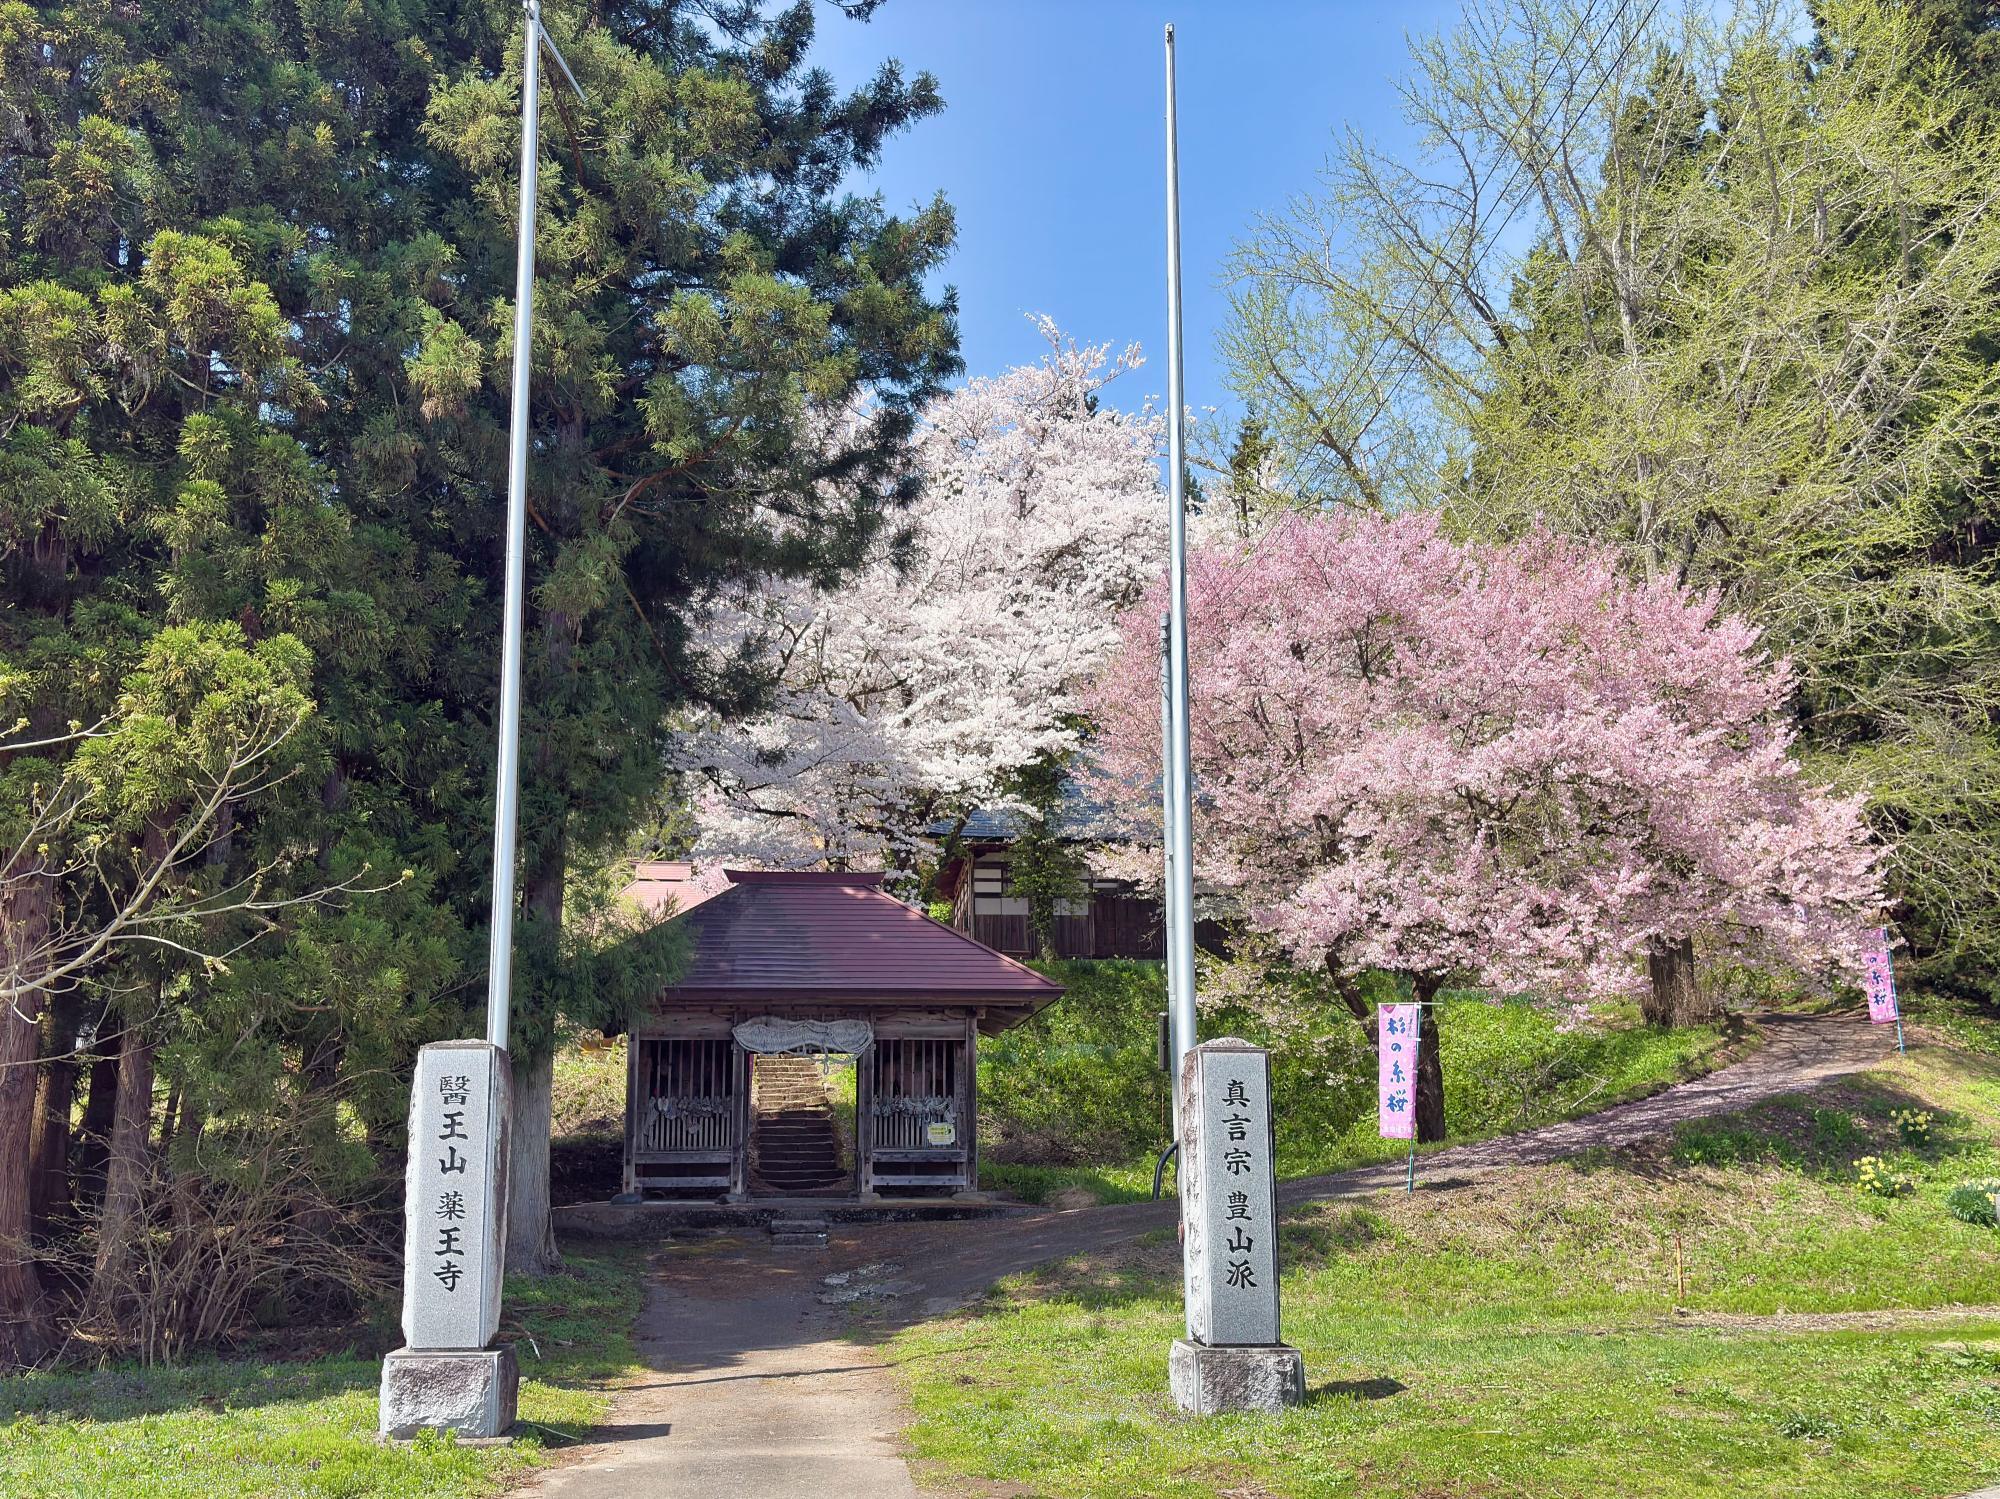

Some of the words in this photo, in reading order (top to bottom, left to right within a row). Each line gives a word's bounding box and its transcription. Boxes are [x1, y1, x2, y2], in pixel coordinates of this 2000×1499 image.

[1386, 1015, 1409, 1113] 杉の糸桜
[438, 1075, 472, 1175] 醫王山
[1221, 1079, 1252, 1176] 真言宗
[433, 1190, 467, 1293] 薬王寺
[1225, 1190, 1258, 1290] 豊山派
